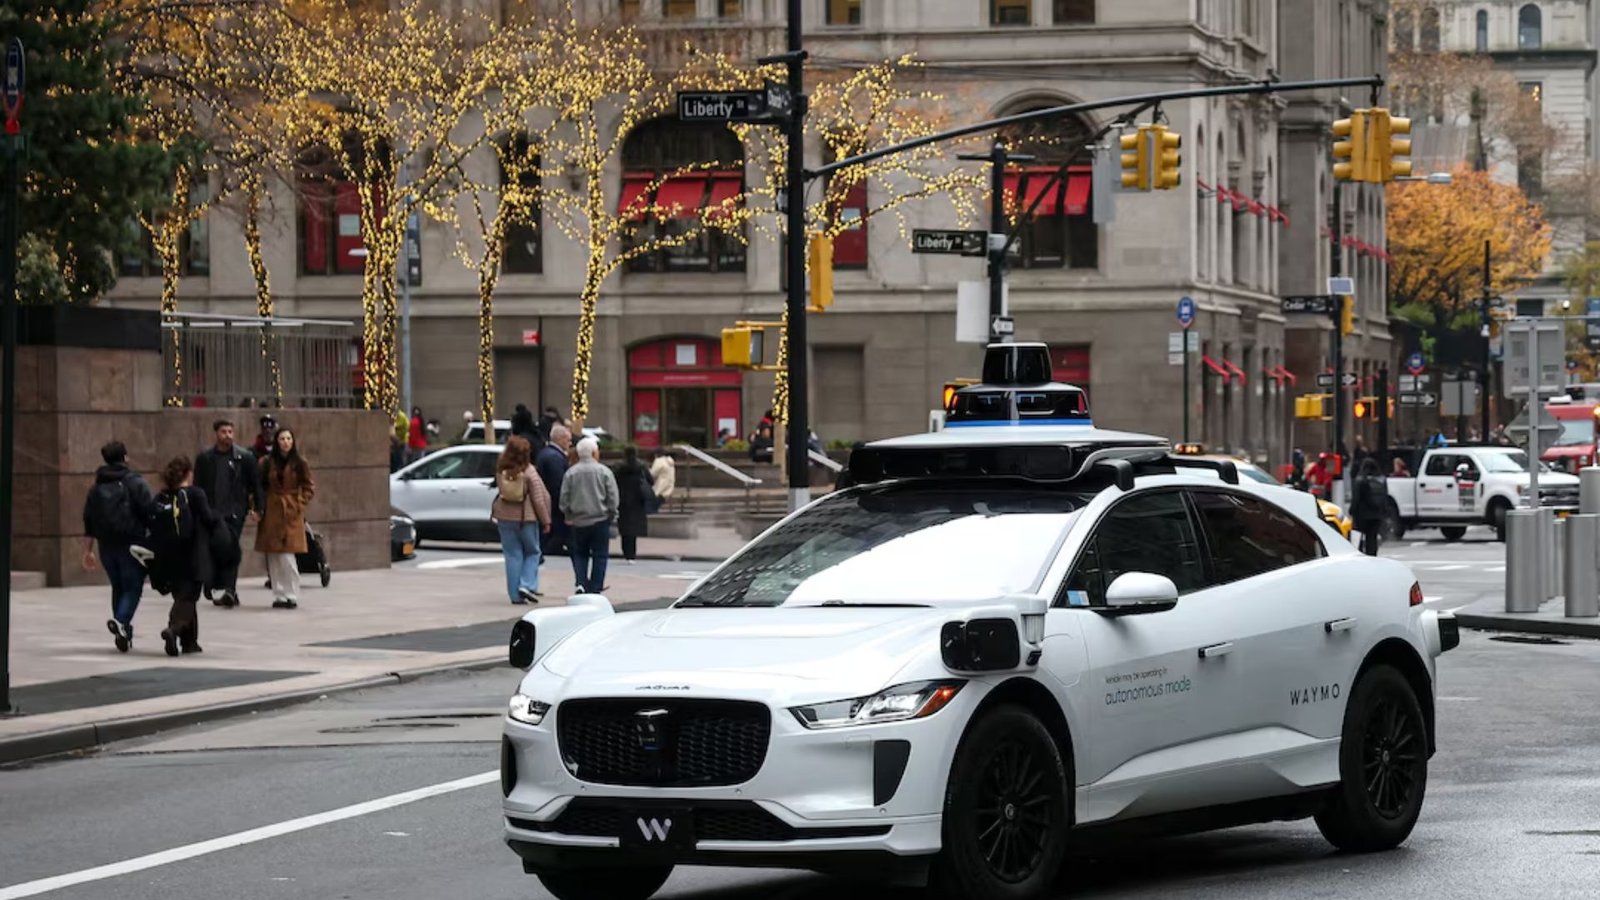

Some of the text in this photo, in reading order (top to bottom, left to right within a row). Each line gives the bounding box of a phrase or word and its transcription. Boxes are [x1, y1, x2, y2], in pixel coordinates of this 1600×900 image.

[684, 100, 734, 119] Liberty
[917, 234, 954, 252] Liberty
[1105, 674, 1192, 705] autonomous mode
[1290, 683, 1340, 706] WAYMO
